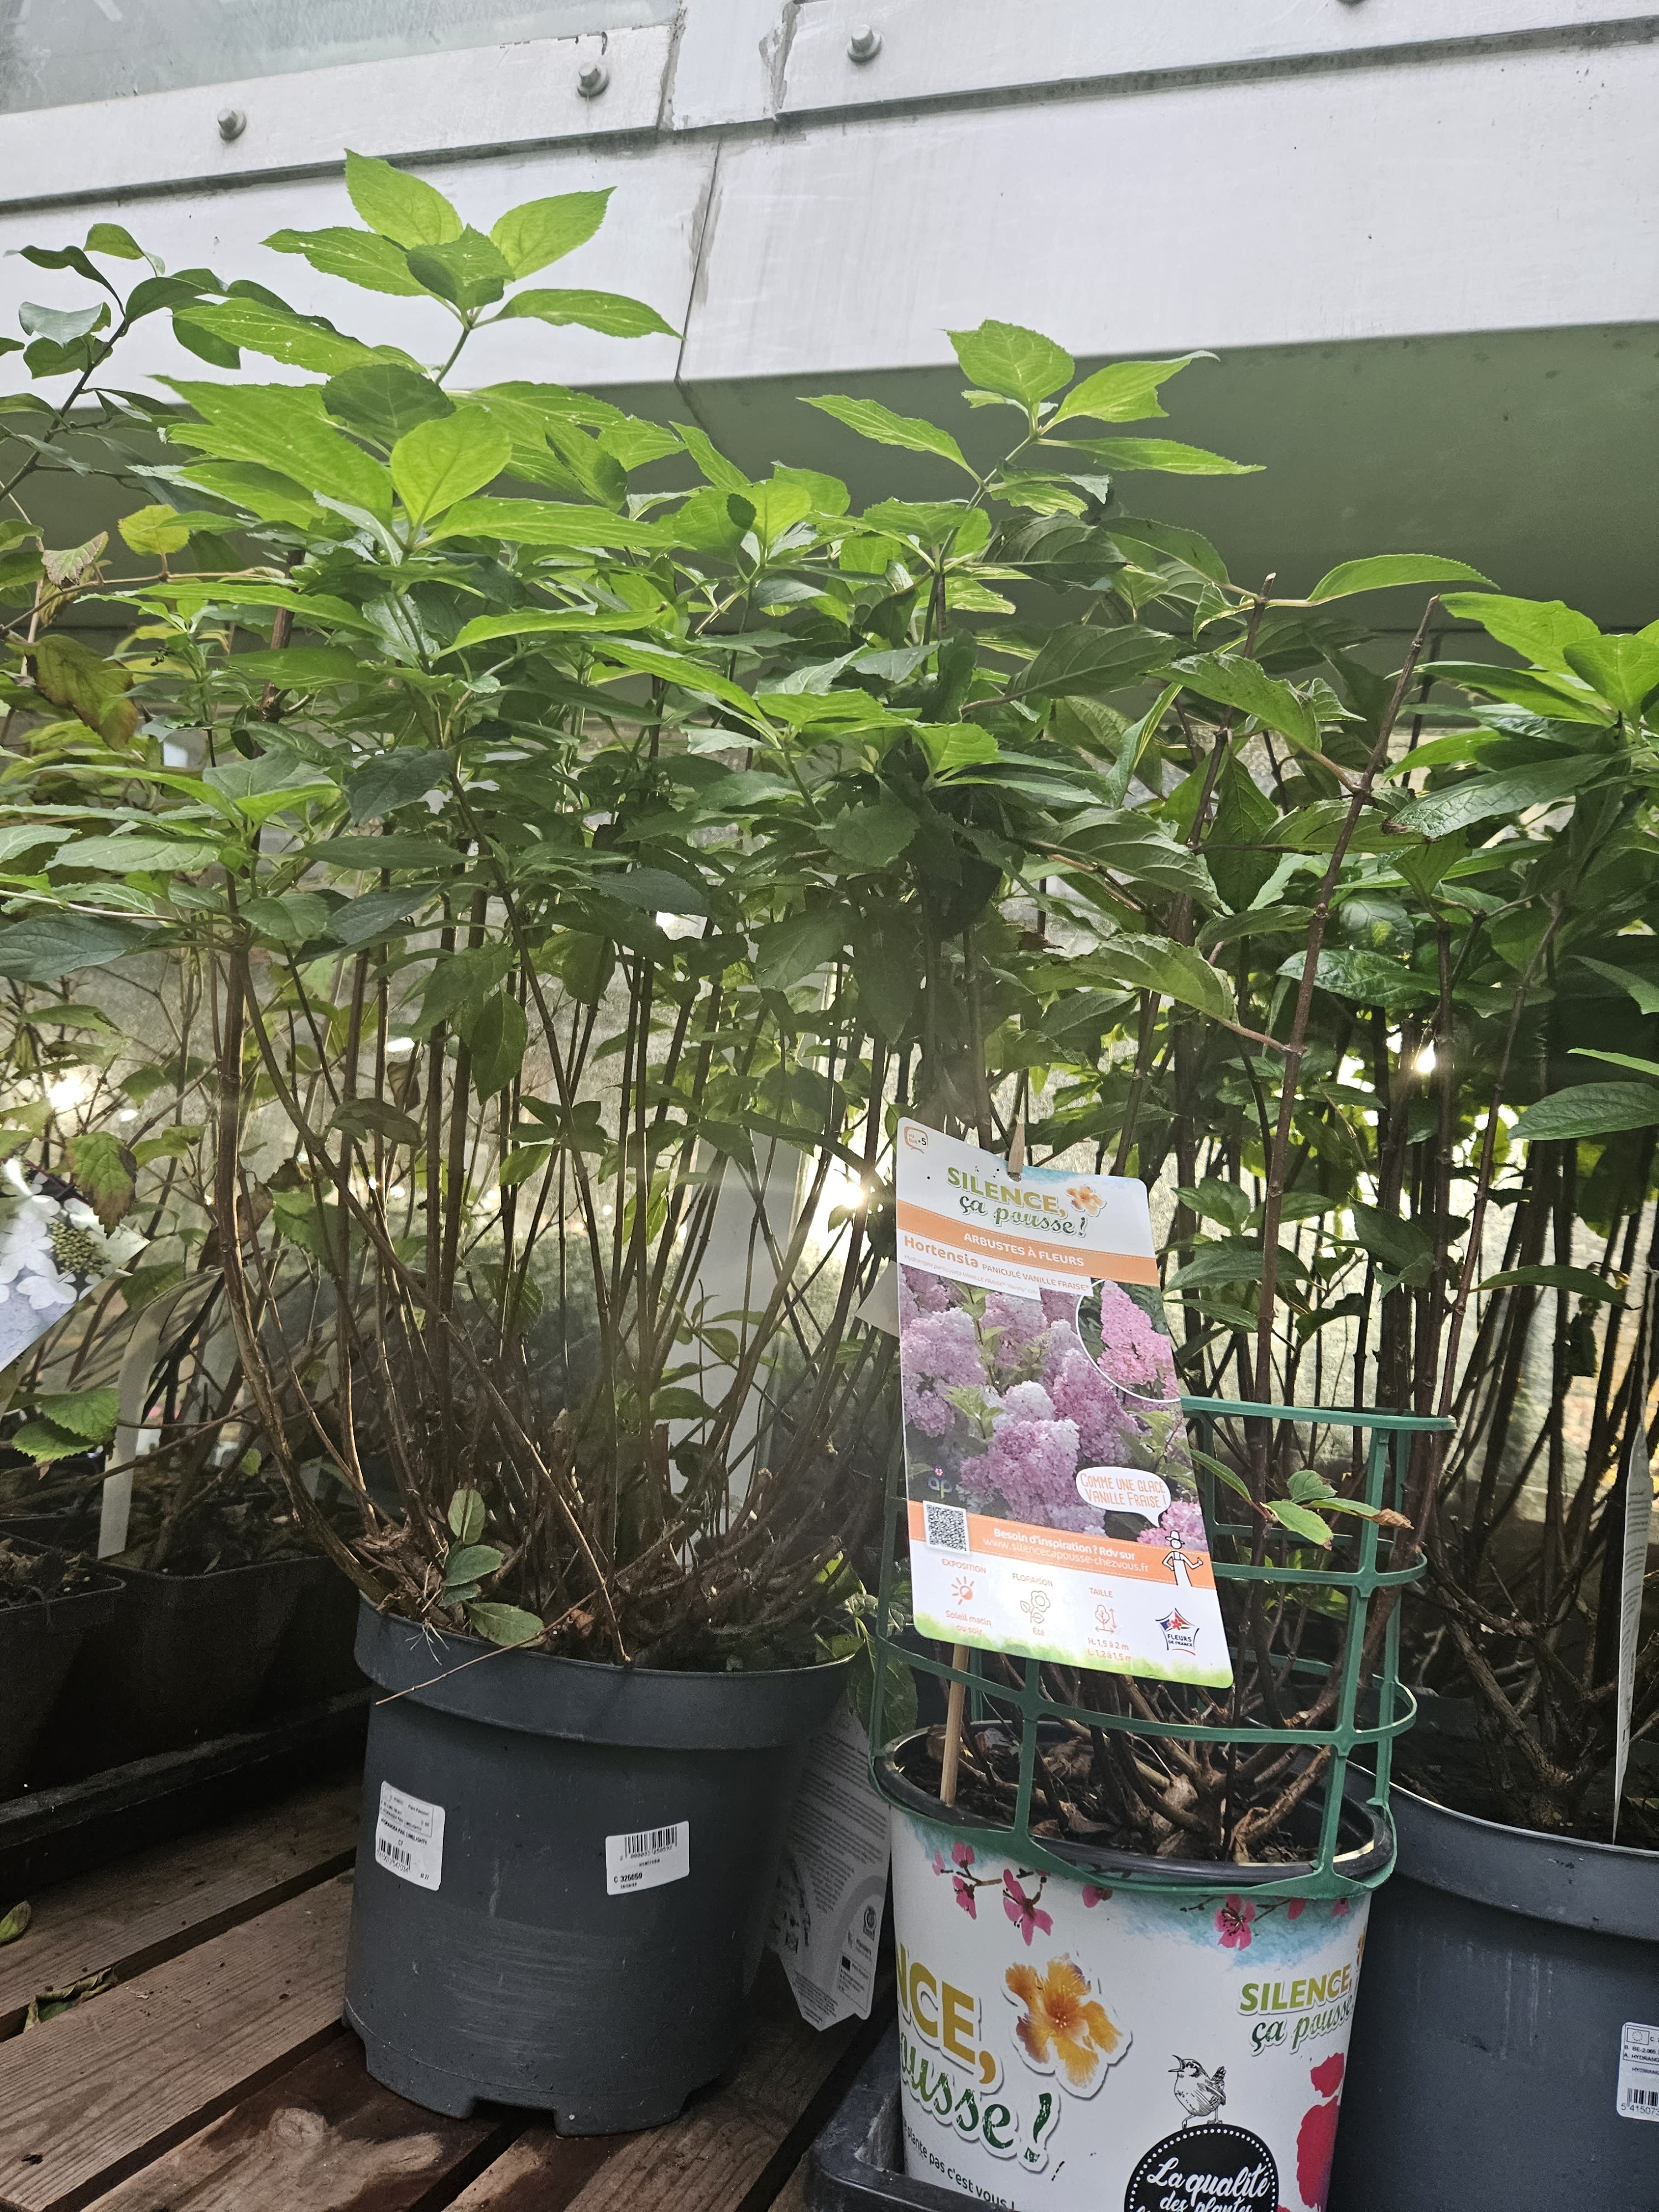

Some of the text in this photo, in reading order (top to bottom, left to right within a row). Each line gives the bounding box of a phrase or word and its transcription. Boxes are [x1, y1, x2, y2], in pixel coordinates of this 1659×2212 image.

[947, 1167, 1067, 1218] SILENCE,
[959, 1196, 986, 1213] ça
[964, 1233, 1084, 1266] ARBUSTES À FLEURS
[904, 1235, 979, 1268] Hortensia
[982, 1264, 1021, 1279] PANICULÉ
[1022, 1273, 1057, 1286] VANILLE
[962, 1272, 985, 1281] VANILLE
[1080, 1473, 1166, 1493] COMME UNE GLACE
[993, 1527, 1028, 1542] Besoin
[1099, 1547, 1119, 1558] Rdv
[983, 1538, 1149, 1572] www.silencecapousse-chezvous.fr
[942, 1558, 987, 1574] EXPOSITION
[1012, 1573, 1053, 1587] FLORAISON
[1088, 1587, 1114, 1598] TAILLE
[946, 1610, 992, 1626] Soleil matin
[968, 1626, 983, 1635] soir
[1167, 1634, 1192, 1642] FLEURS
[614, 1875, 618, 1884] C
[1240, 1963, 1353, 2011] SILENCE,
[1251, 2020, 1285, 2052] ça
[930, 2152, 945, 2173] pas
[947, 2167, 974, 2193] c'est
[1146, 2157, 1270, 2207] La qualité
[1160, 2189, 1188, 2212] des
